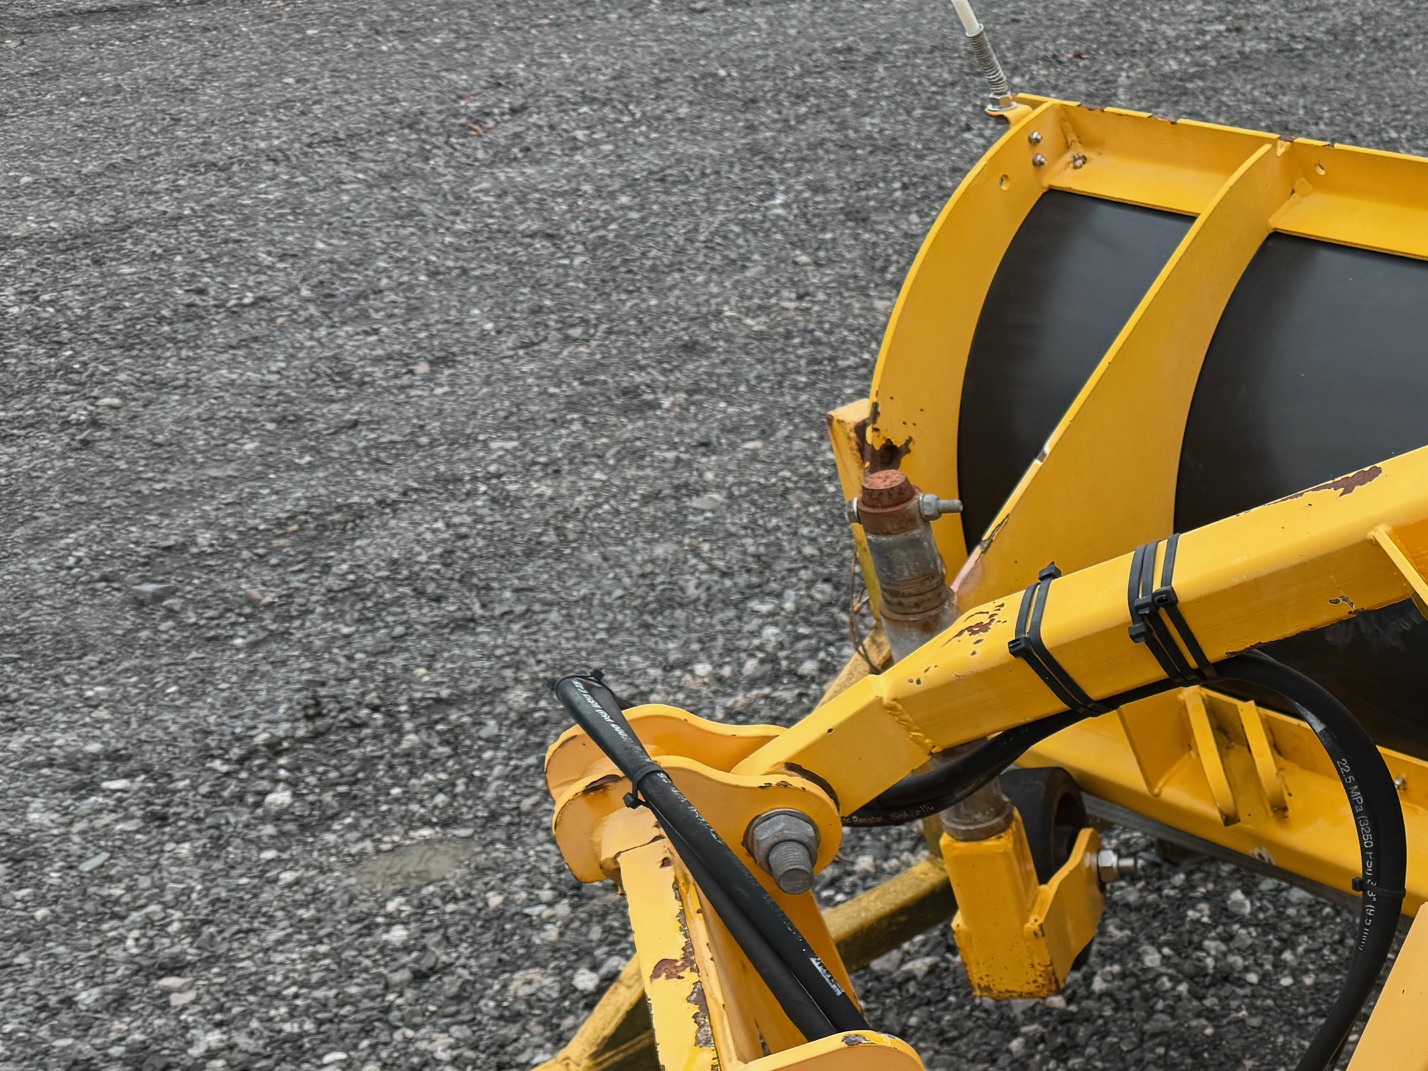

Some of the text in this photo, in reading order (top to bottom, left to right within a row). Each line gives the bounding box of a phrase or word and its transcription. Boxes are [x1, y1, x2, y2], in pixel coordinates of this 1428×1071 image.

[1336, 758, 1355, 784] 22.5
[1349, 785, 1364, 812] MPa
[1357, 815, 1374, 848] (3250
